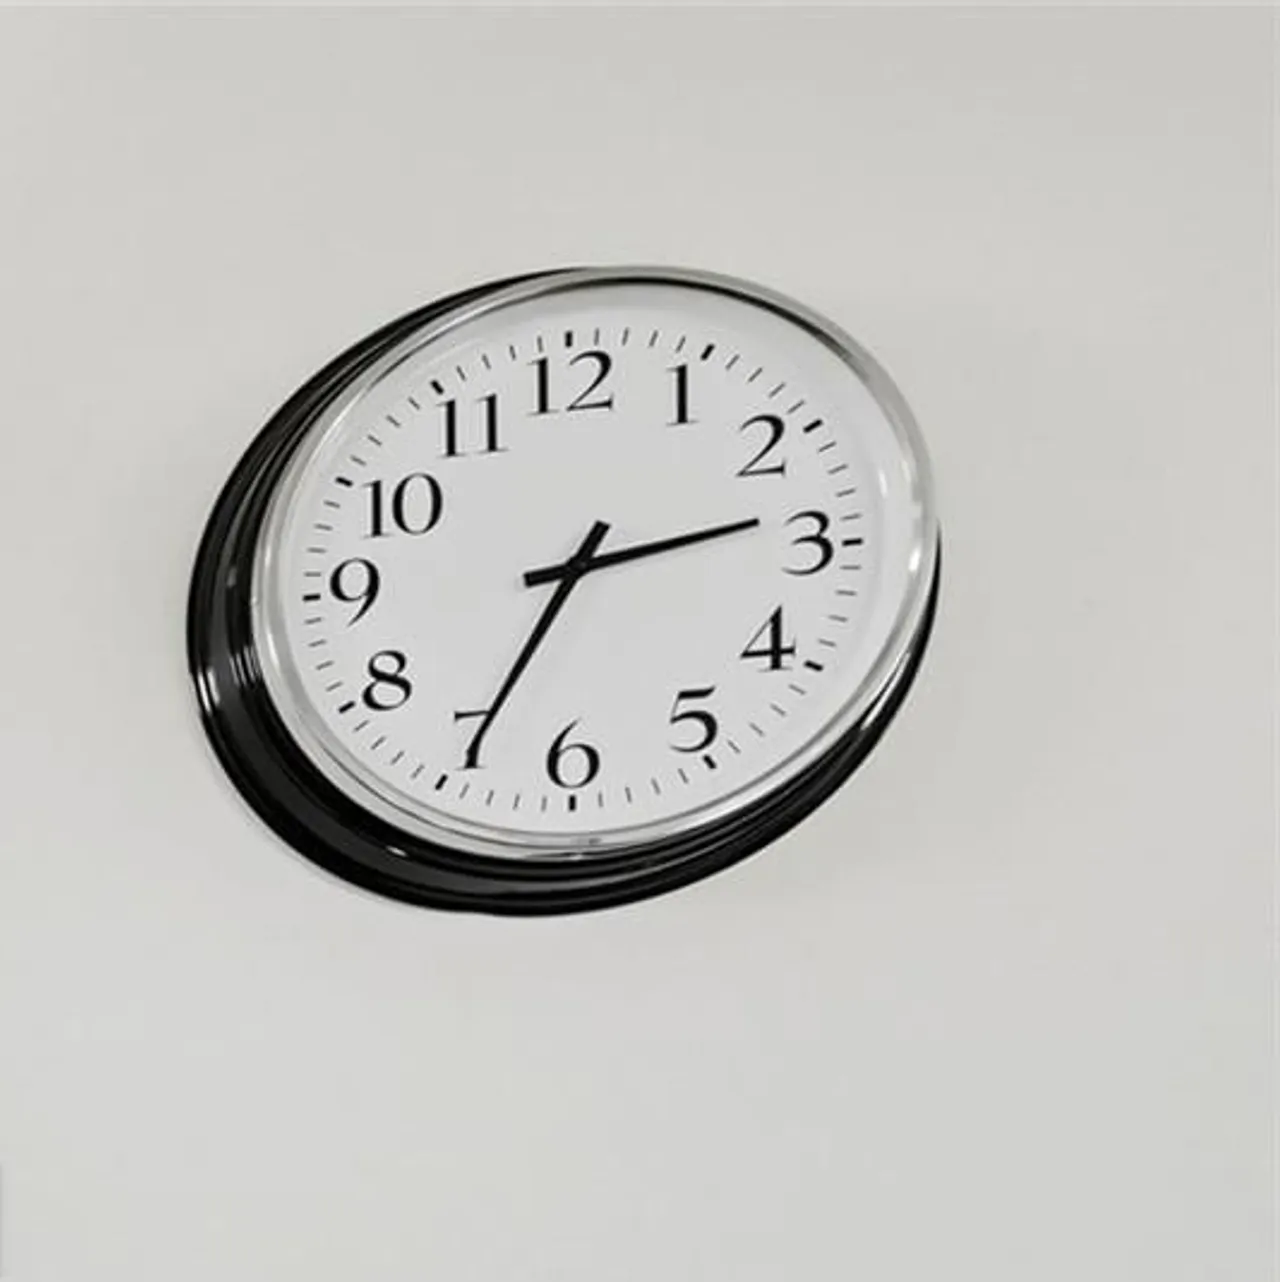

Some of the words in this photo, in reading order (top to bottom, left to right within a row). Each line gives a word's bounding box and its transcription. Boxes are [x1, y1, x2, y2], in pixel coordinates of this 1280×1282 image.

[527, 349, 614, 416] 12
[666, 364, 699, 426] 1
[439, 393, 509, 459] 11
[736, 413, 787, 477] 2
[361, 472, 444, 539] 10
[782, 510, 835, 576] 3
[329, 557, 381, 627] 9
[739, 604, 797, 673] 4
[361, 650, 412, 712] 8
[453, 709, 493, 770] 7
[669, 685, 719, 754] 5
[546, 718, 601, 789] 6
